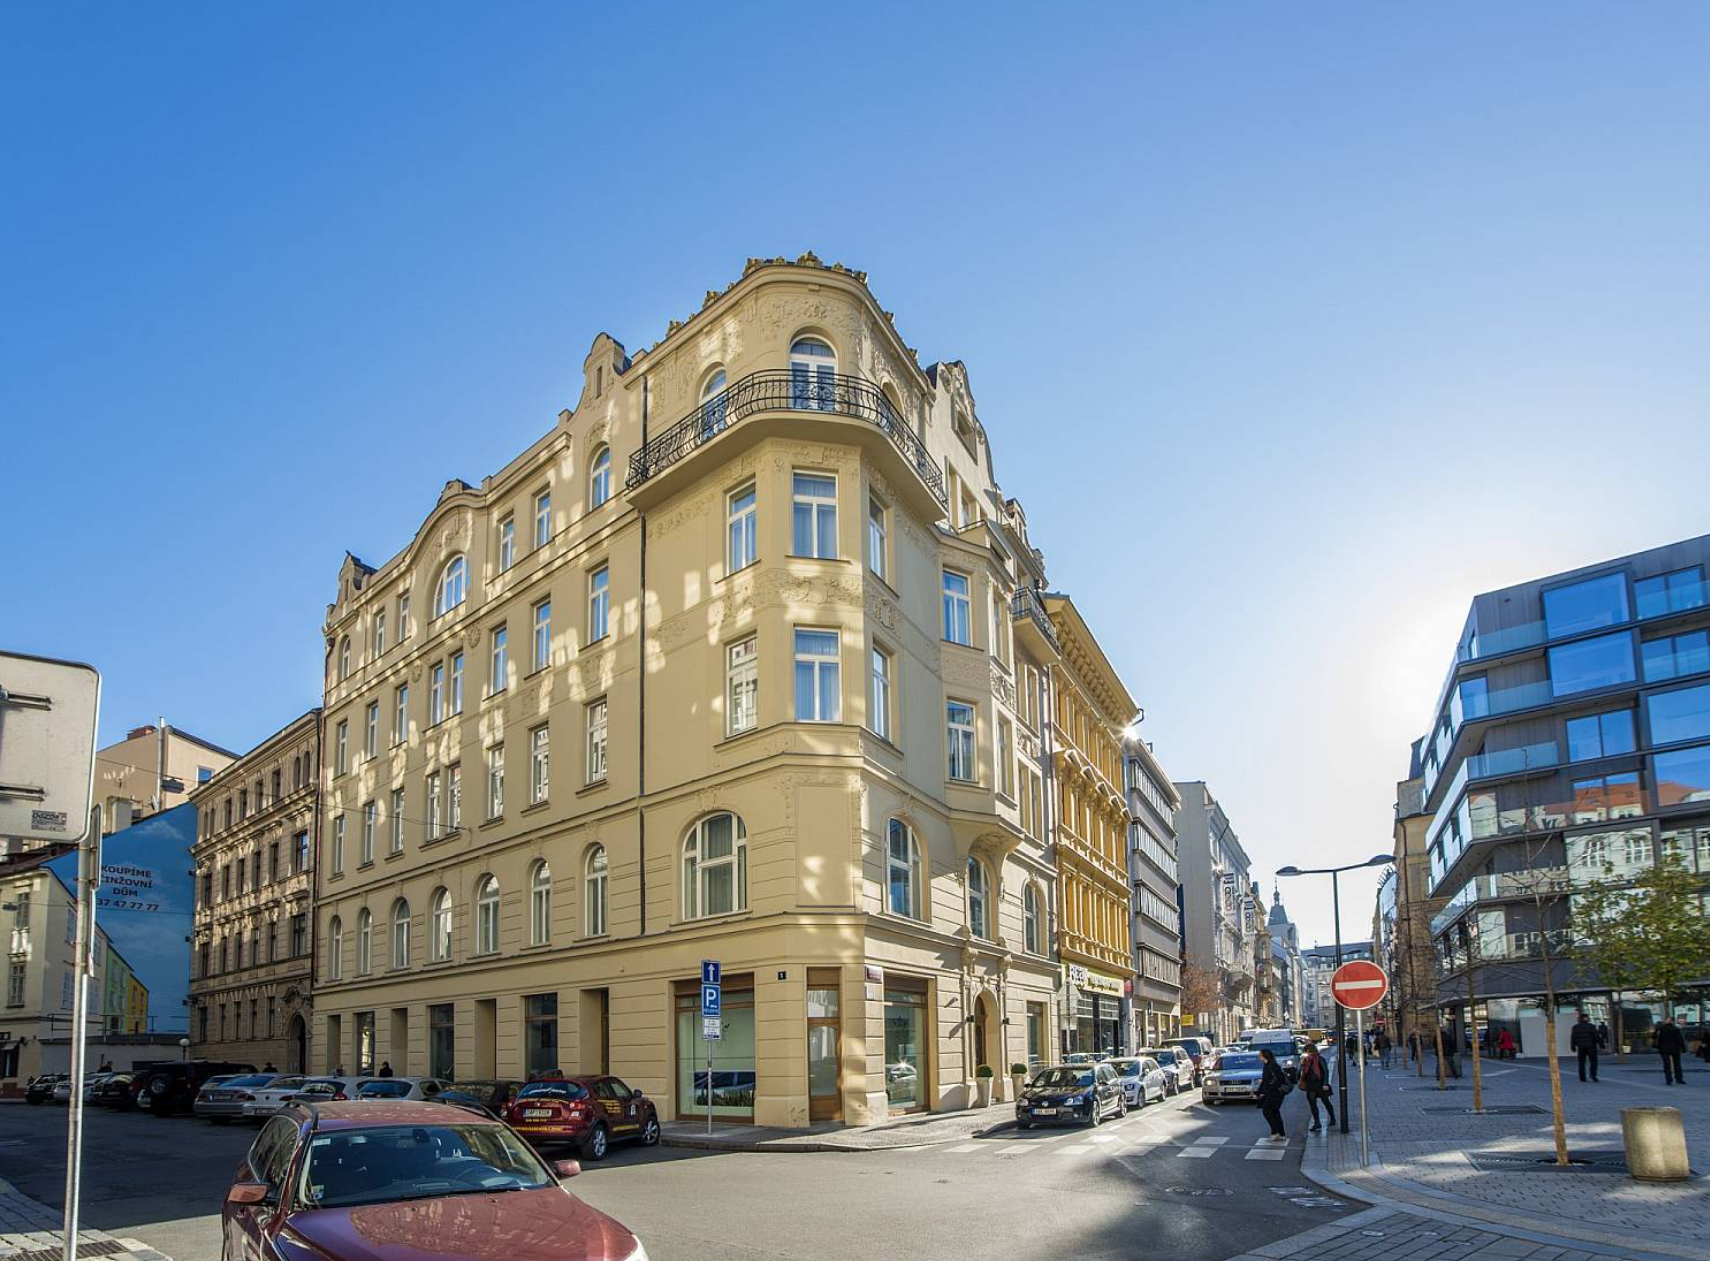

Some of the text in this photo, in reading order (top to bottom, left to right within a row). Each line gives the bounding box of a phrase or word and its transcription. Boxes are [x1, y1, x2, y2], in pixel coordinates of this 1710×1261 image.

[112, 886, 138, 897] DŮM
[113, 900, 127, 908] 47
[129, 901, 143, 909] 77
[145, 903, 159, 911] 77
[705, 988, 716, 1006] P
